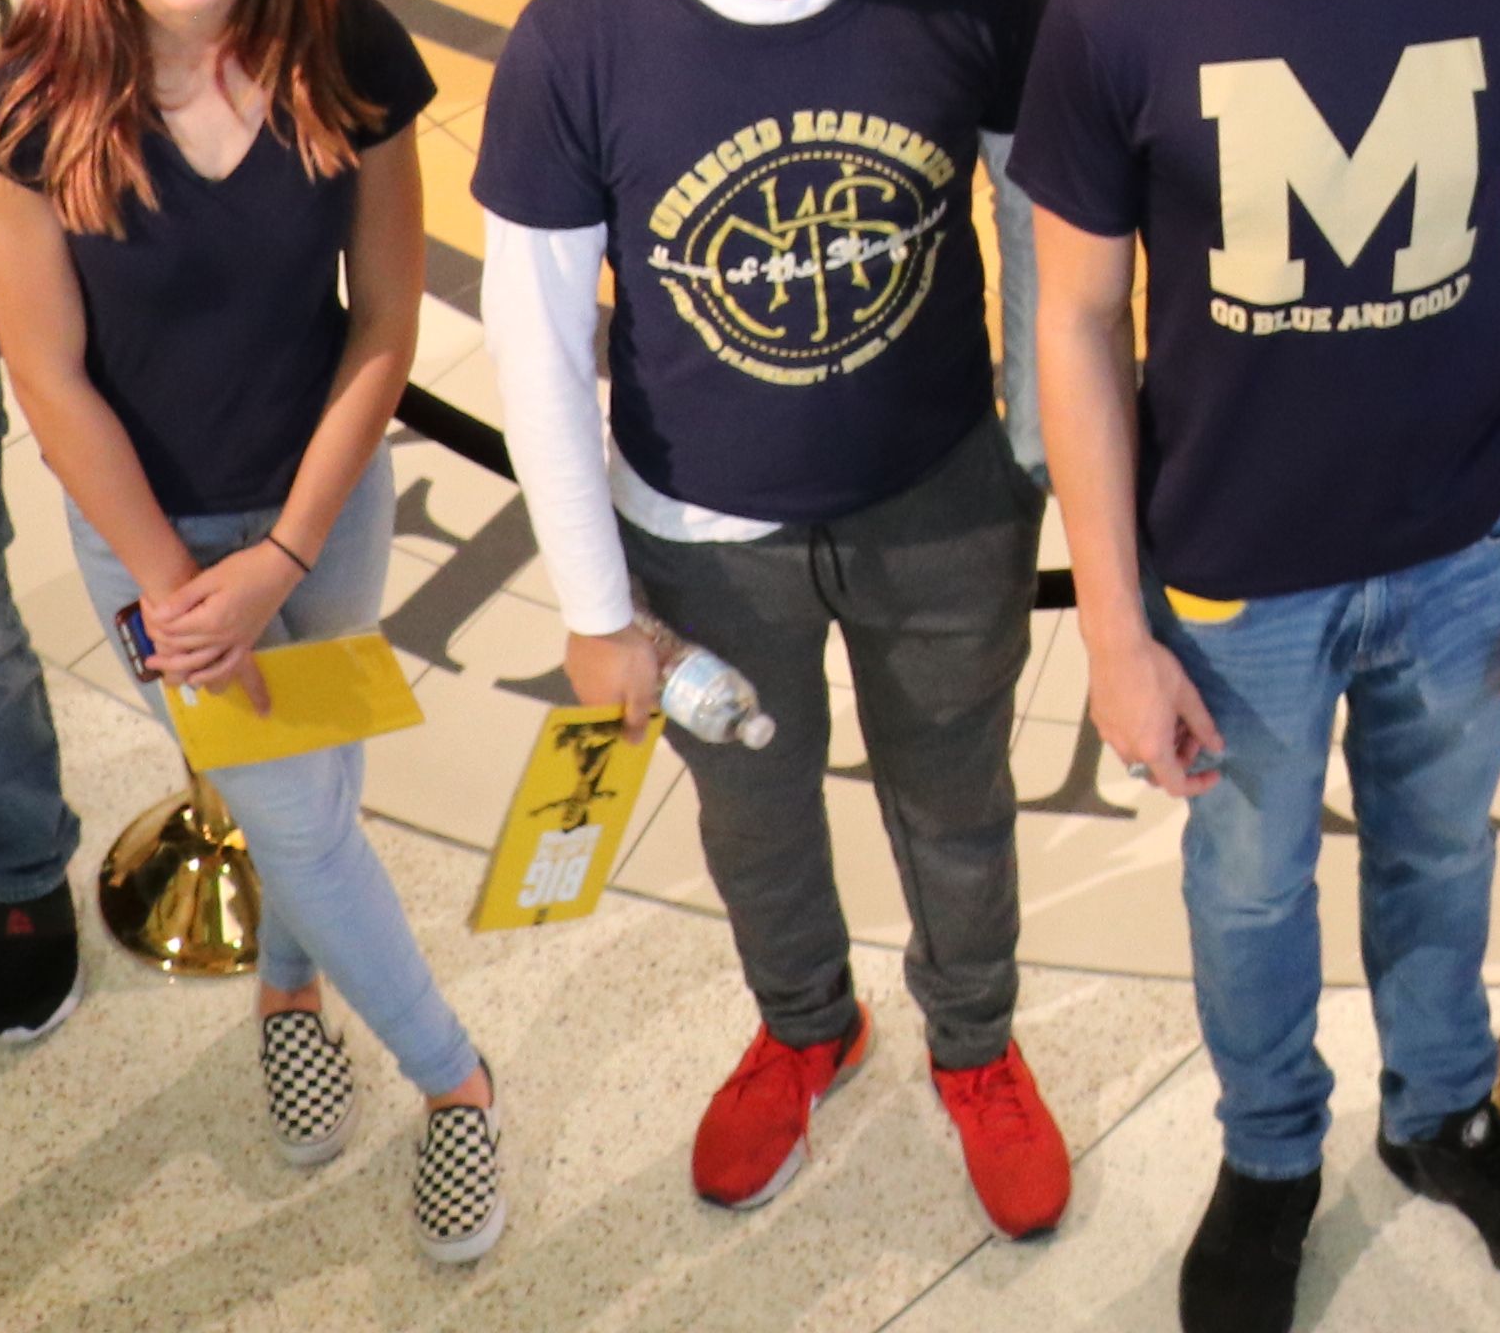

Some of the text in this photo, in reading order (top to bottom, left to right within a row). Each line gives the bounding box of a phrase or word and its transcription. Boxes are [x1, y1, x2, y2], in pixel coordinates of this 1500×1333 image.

[1200, 36, 1487, 306] M
[1210, 273, 1471, 336] GO BLUE AND GOLD
